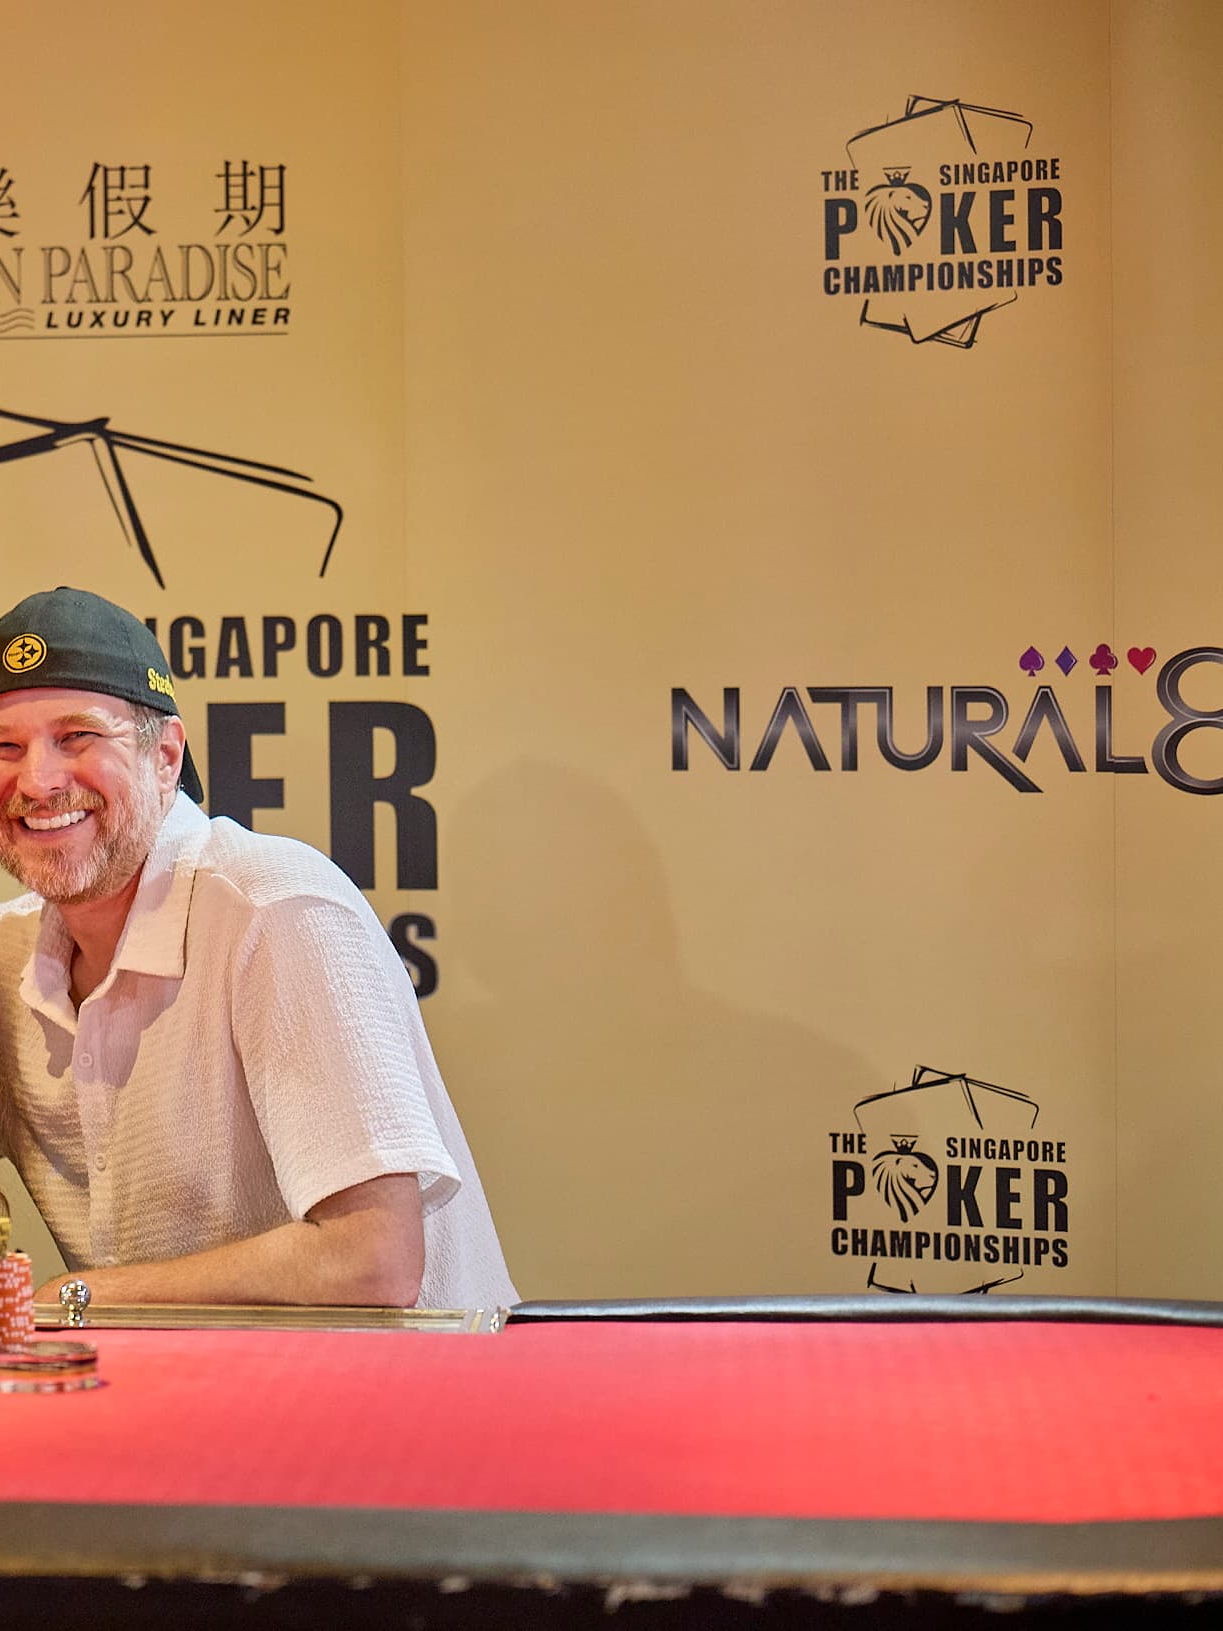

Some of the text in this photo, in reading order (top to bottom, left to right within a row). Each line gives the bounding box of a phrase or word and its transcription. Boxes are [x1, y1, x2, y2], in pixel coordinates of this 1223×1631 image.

[821, 158, 1060, 192] THE SINGAPORE
[40, 242, 291, 304] PARADISE
[824, 256, 1063, 295] CHAMPIONSHIPS
[45, 306, 291, 330] LUXURY LINER
[144, 613, 431, 680] GAPORE
[829, 1132, 1066, 1163] THE SINGAPORE
[831, 1227, 1069, 1268] CHAMPIONSHIPS
